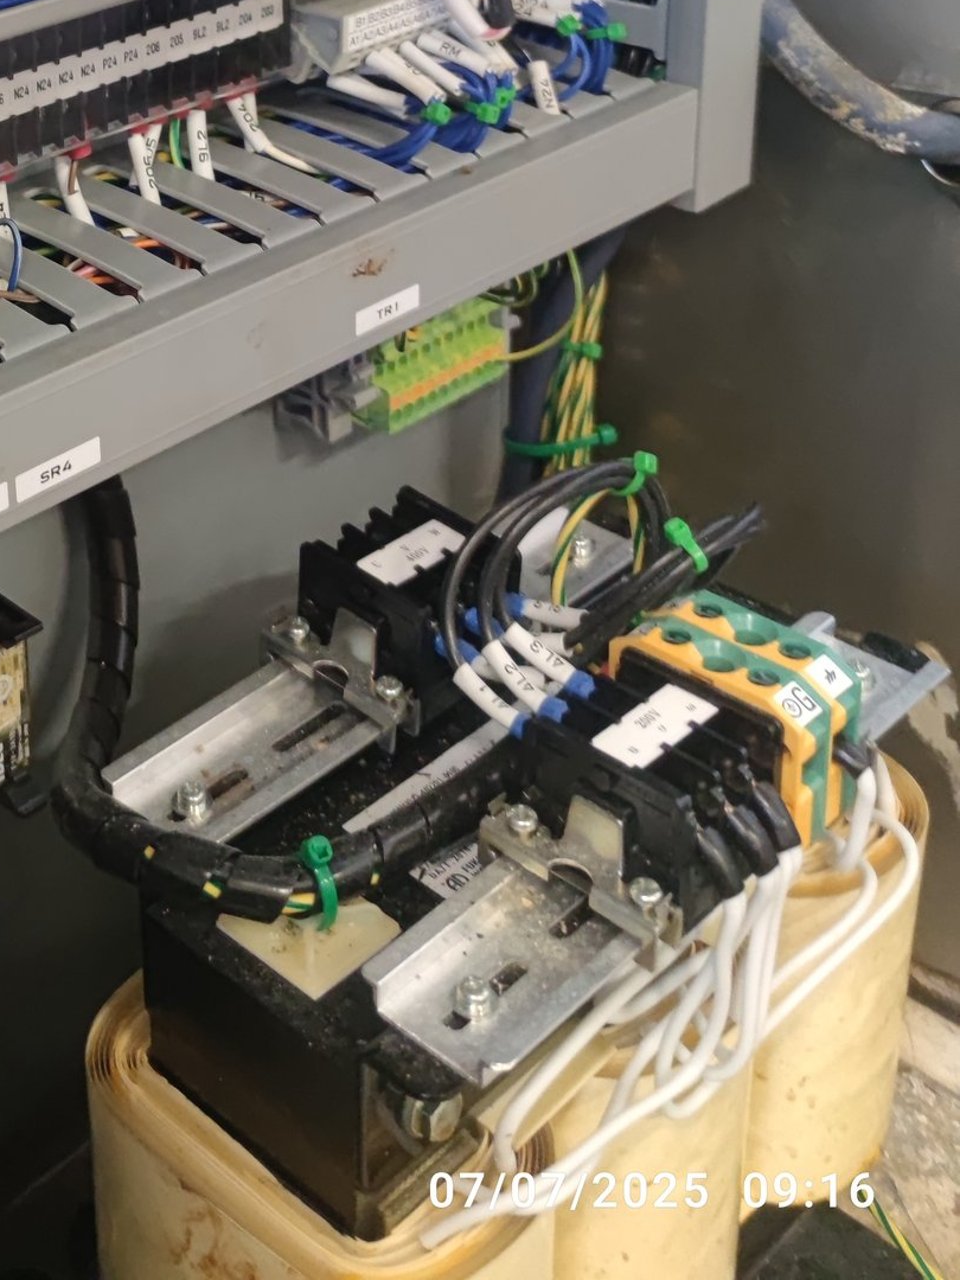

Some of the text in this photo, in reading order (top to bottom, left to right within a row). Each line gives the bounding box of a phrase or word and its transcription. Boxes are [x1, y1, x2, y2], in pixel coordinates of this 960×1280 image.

[13, 86, 30, 101] N24
[36, 79, 52, 93] N24
[58, 71, 74, 86] N24
[80, 63, 96, 78] N24
[102, 56, 118, 70] P24
[123, 49, 139, 64] P24
[376, 300, 400, 319] TR1
[38, 459, 74, 485] SR4
